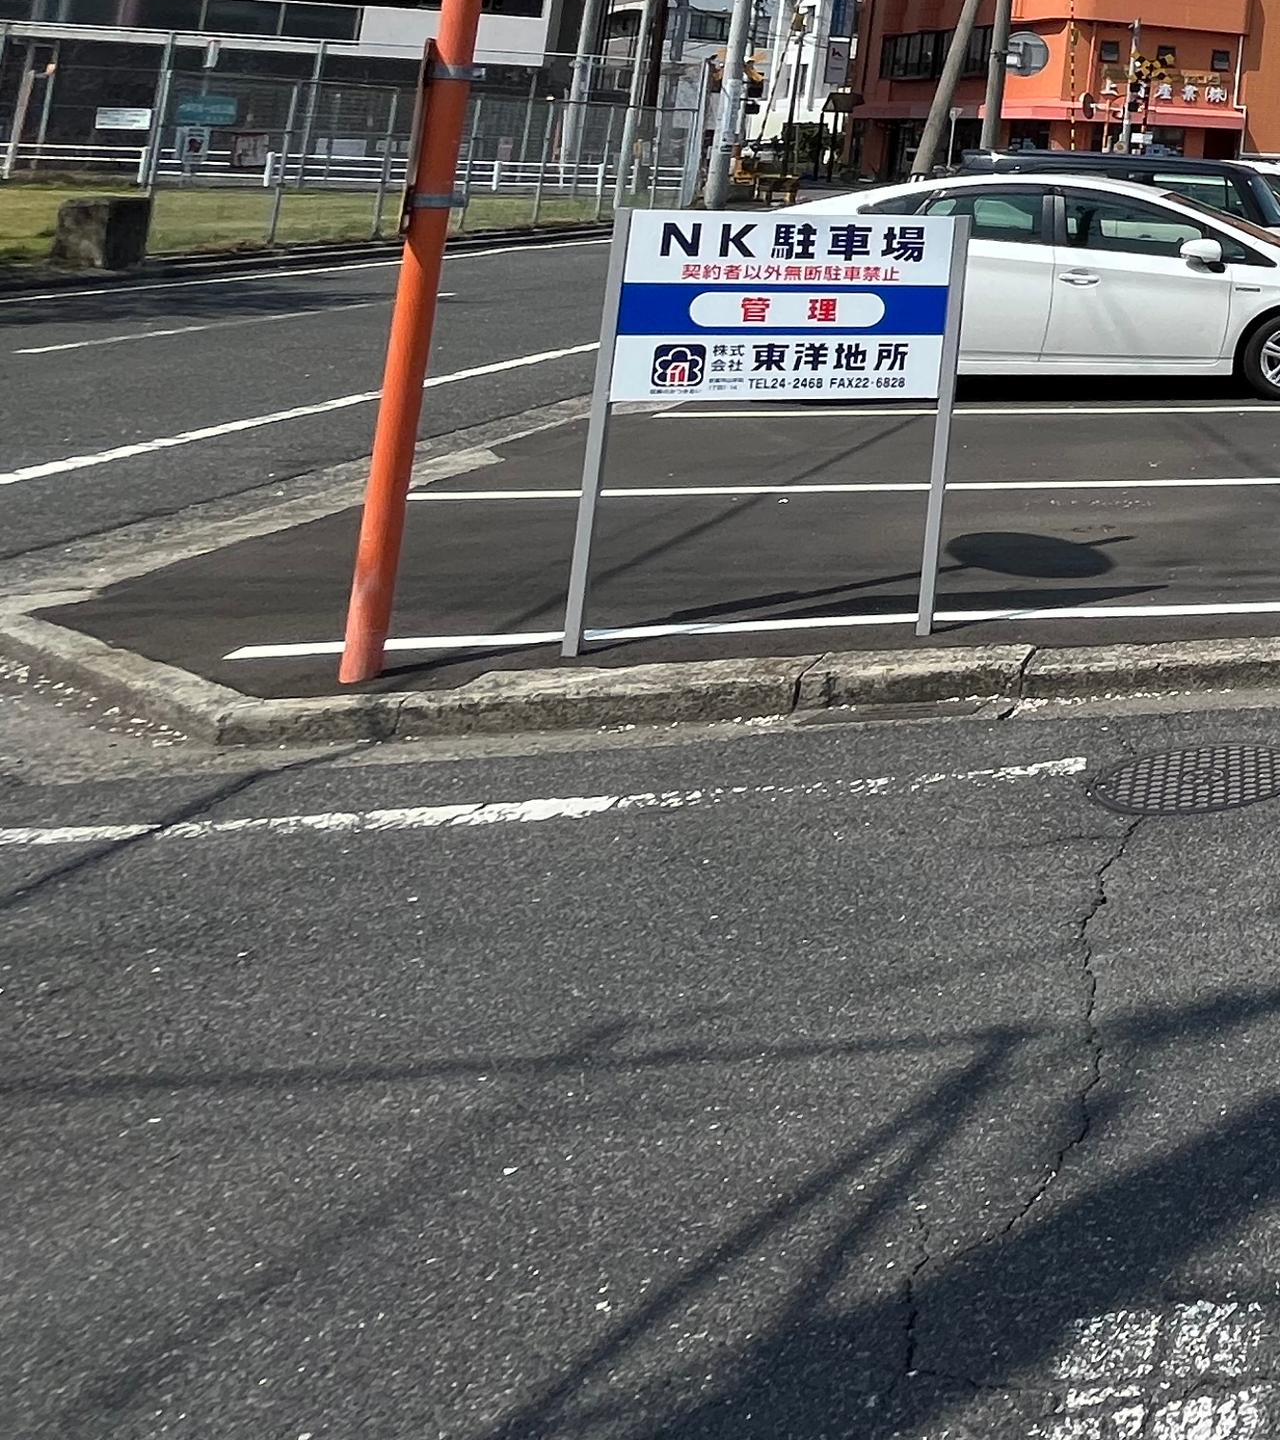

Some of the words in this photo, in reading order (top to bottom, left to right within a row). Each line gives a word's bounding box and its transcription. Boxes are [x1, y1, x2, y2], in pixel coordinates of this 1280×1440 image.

[681, 264, 900, 282] 契約者以外無断駐車禁止
[740, 296, 838, 323] 管理
[750, 342, 910, 372] 東洋地所
